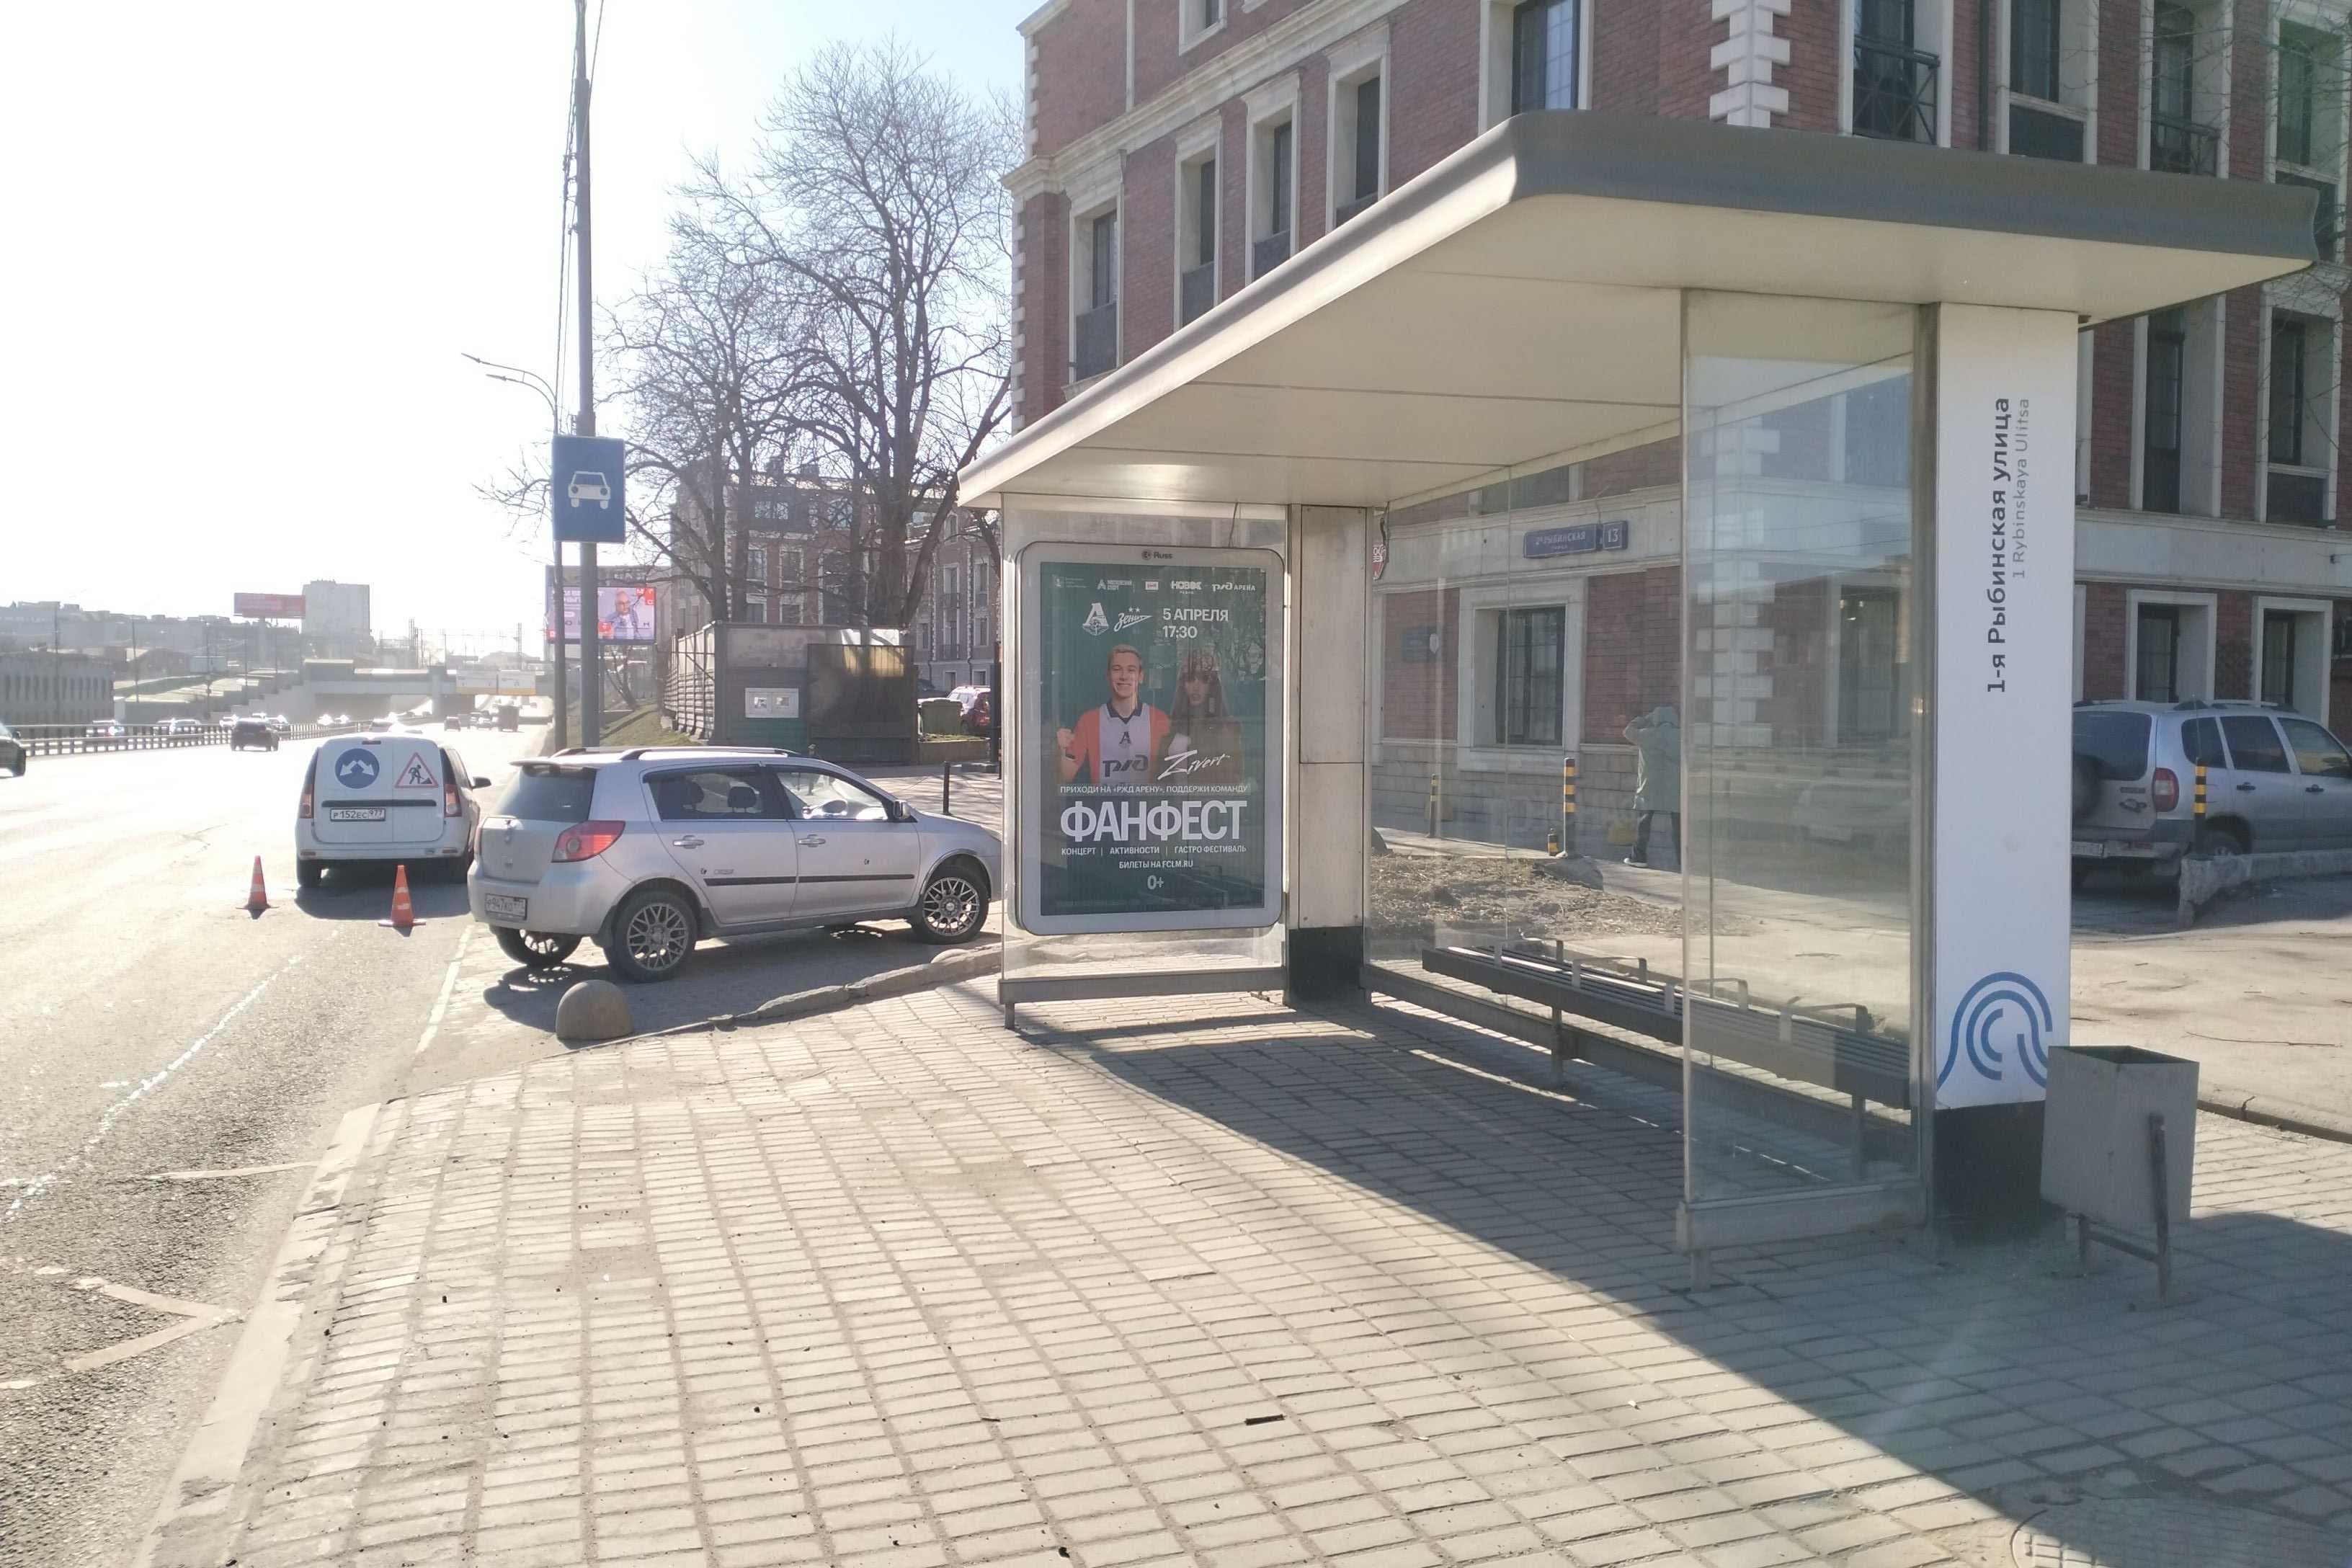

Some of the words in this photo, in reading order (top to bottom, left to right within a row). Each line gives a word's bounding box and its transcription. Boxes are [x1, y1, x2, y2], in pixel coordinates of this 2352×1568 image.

[1993, 398, 2011, 482] улица
[2015, 398, 2029, 452] Ulitsa
[2012, 458, 2030, 563] Rybinskaya
[1607, 528, 1619, 543] 13
[1987, 490, 2007, 643] Рыбинская
[1162, 608, 1171, 620] 5
[1173, 609, 1229, 622] АПРЕЛЯ
[1162, 625, 1198, 638] 17:30
[1987, 654, 2006, 692] 1-я
[1157, 749, 1231, 780] Zivert
[1060, 800, 1247, 842] ФАНФЕСТ
[1061, 847, 1096, 855] КОНЦЕРТ
[1110, 846, 1160, 855] АКТИВНОСТИ
[1175, 845, 1202, 854] ГАСТРО
[1119, 860, 1149, 869] БИЛЕТЫ
[1162, 860, 1193, 868] FCLM.RU
[1147, 875, 1164, 890] 0+
